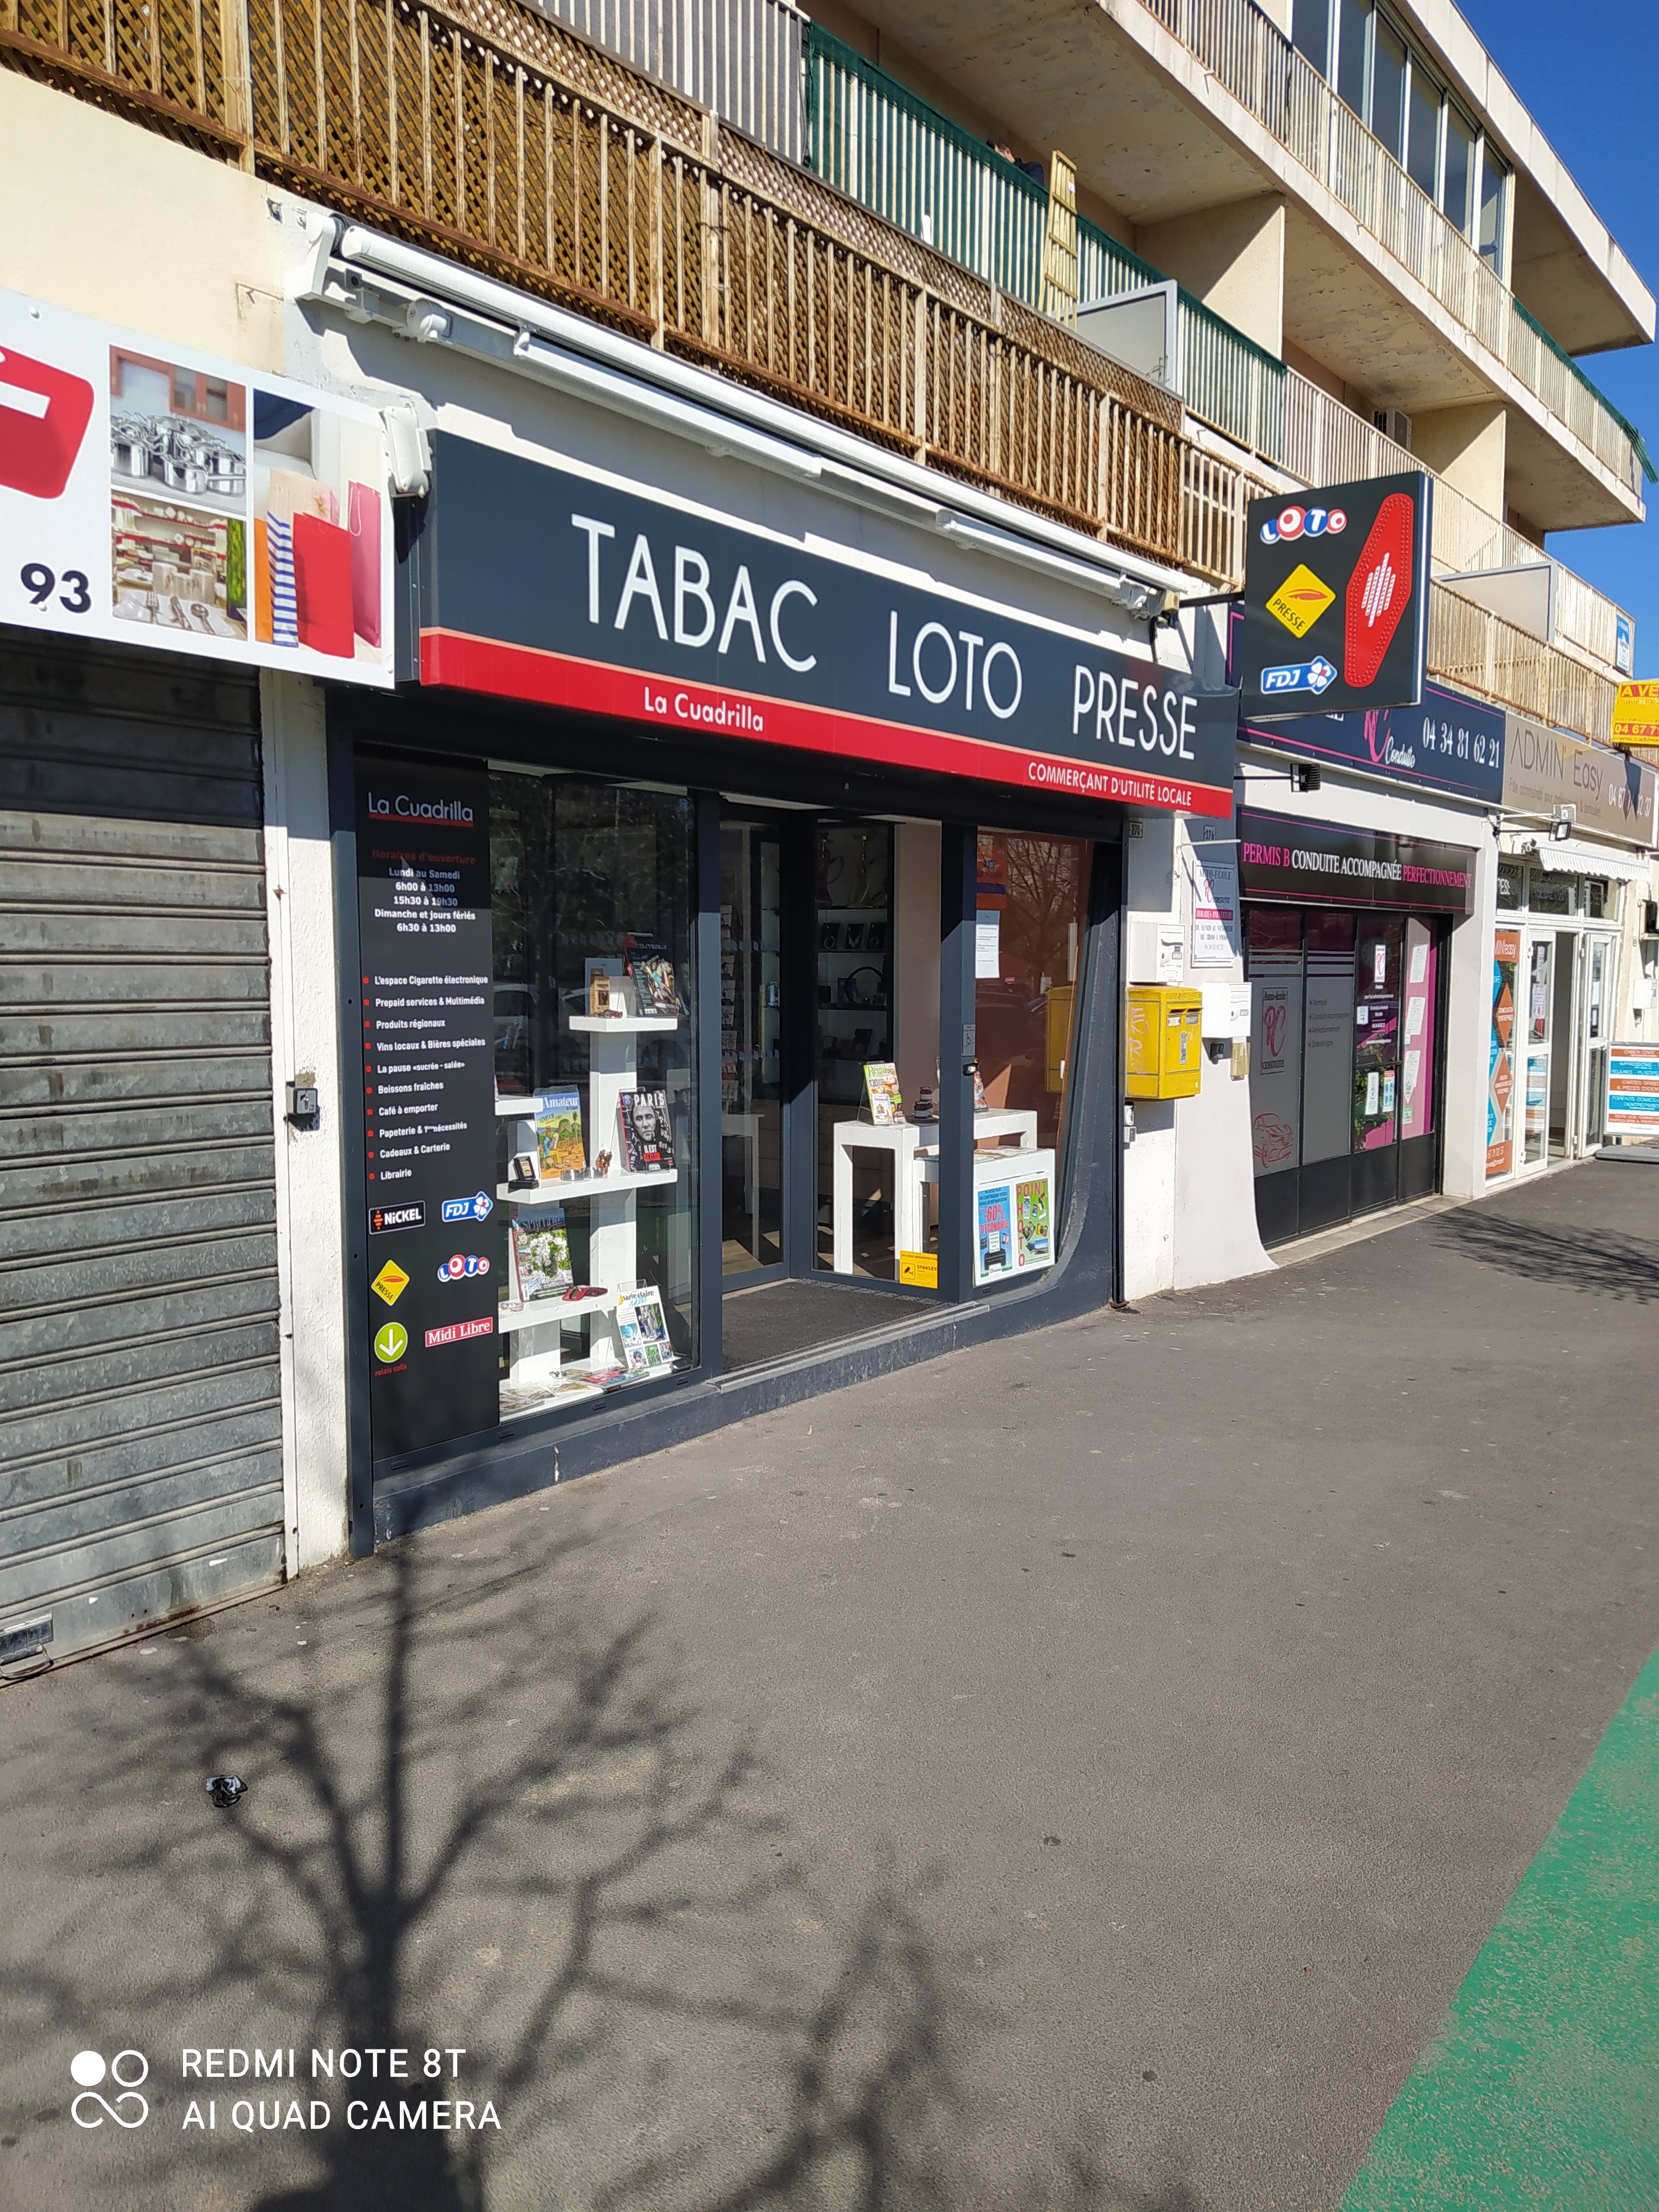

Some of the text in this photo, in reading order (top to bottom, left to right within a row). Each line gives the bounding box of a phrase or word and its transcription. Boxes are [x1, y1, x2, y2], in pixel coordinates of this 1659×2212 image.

[1261, 507, 1345, 542] LOTO
[20, 562, 92, 614] 93
[571, 513, 818, 672] TABAC
[1272, 597, 1306, 633] PRESSE
[889, 610, 1022, 719] LOTO
[1265, 669, 1302, 689] FDJ
[644, 686, 764, 732] La Cuadrilla
[1072, 664, 1198, 760] PRESSE
[1615, 724, 1629, 734] 04
[1632, 724, 1647, 734] 67
[1423, 717, 1500, 769] 04 34 81 62 21
[1385, 735, 1416, 769] Conduite
[1573, 748, 1604, 801] Easy
[1029, 761, 1192, 807] COMMERÇANT D'UTILITÉ LOCALE
[1608, 782, 1617, 807] 04
[1618, 786, 1626, 810] 67
[368, 791, 474, 822] La Cuadrilla
[389, 867, 460, 880] Lundi au Samedi
[1243, 842, 1281, 865] PERMIS
[1283, 847, 1290, 868] B
[1292, 849, 1340, 874] CONDUITE
[1341, 857, 1402, 881] ACCOMPAGNÉE
[1402, 866, 1472, 889] PERFECTIONNEMENT
[395, 880, 455, 893] 6h00 à 13h00
[393, 894, 458, 906] 15h30 à 19h30
[374, 908, 476, 921] Dimanche et jours fériés
[397, 921, 456, 932] 6h30 à 13h00
[374, 975, 488, 986] L'espace Cigarette électronique
[375, 996, 485, 1008] Prepaid services & Multimédia
[376, 1019, 446, 1029] Produits régionaux
[377, 1038, 486, 1051] Vins locaux & Bières spéciales
[377, 1065, 387, 1073] La
[388, 1065, 411, 1074] pause
[413, 1062, 439, 1071] «sucrée
[444, 1061, 465, 1070] salée»
[378, 1082, 444, 1094] Boissons fraîches
[869, 1078, 878, 1088] 130
[543, 1096, 579, 1108] Amateur
[634, 1093, 665, 1107] PARIS
[379, 1104, 439, 1116] Café à emporter
[379, 1126, 416, 1139] Papeterie
[417, 1125, 423, 1134] &
[434, 1121, 468, 1133] nécessités
[380, 1142, 451, 1159] Cadeaux & Carterie
[380, 1168, 413, 1180] Librairie
[1016, 1180, 1047, 1197] POINT
[384, 1207, 422, 1225] NiCKEL
[445, 1202, 469, 1218] FDJ
[984, 1204, 1004, 1221] -60%
[980, 1219, 1009, 1234] D'ECONOMIE
[439, 1255, 489, 1281] LOTO
[375, 1281, 394, 1301] PRESSE
[428, 1321, 491, 1345] Midi Libre
[374, 1363, 407, 1376] relais colis
